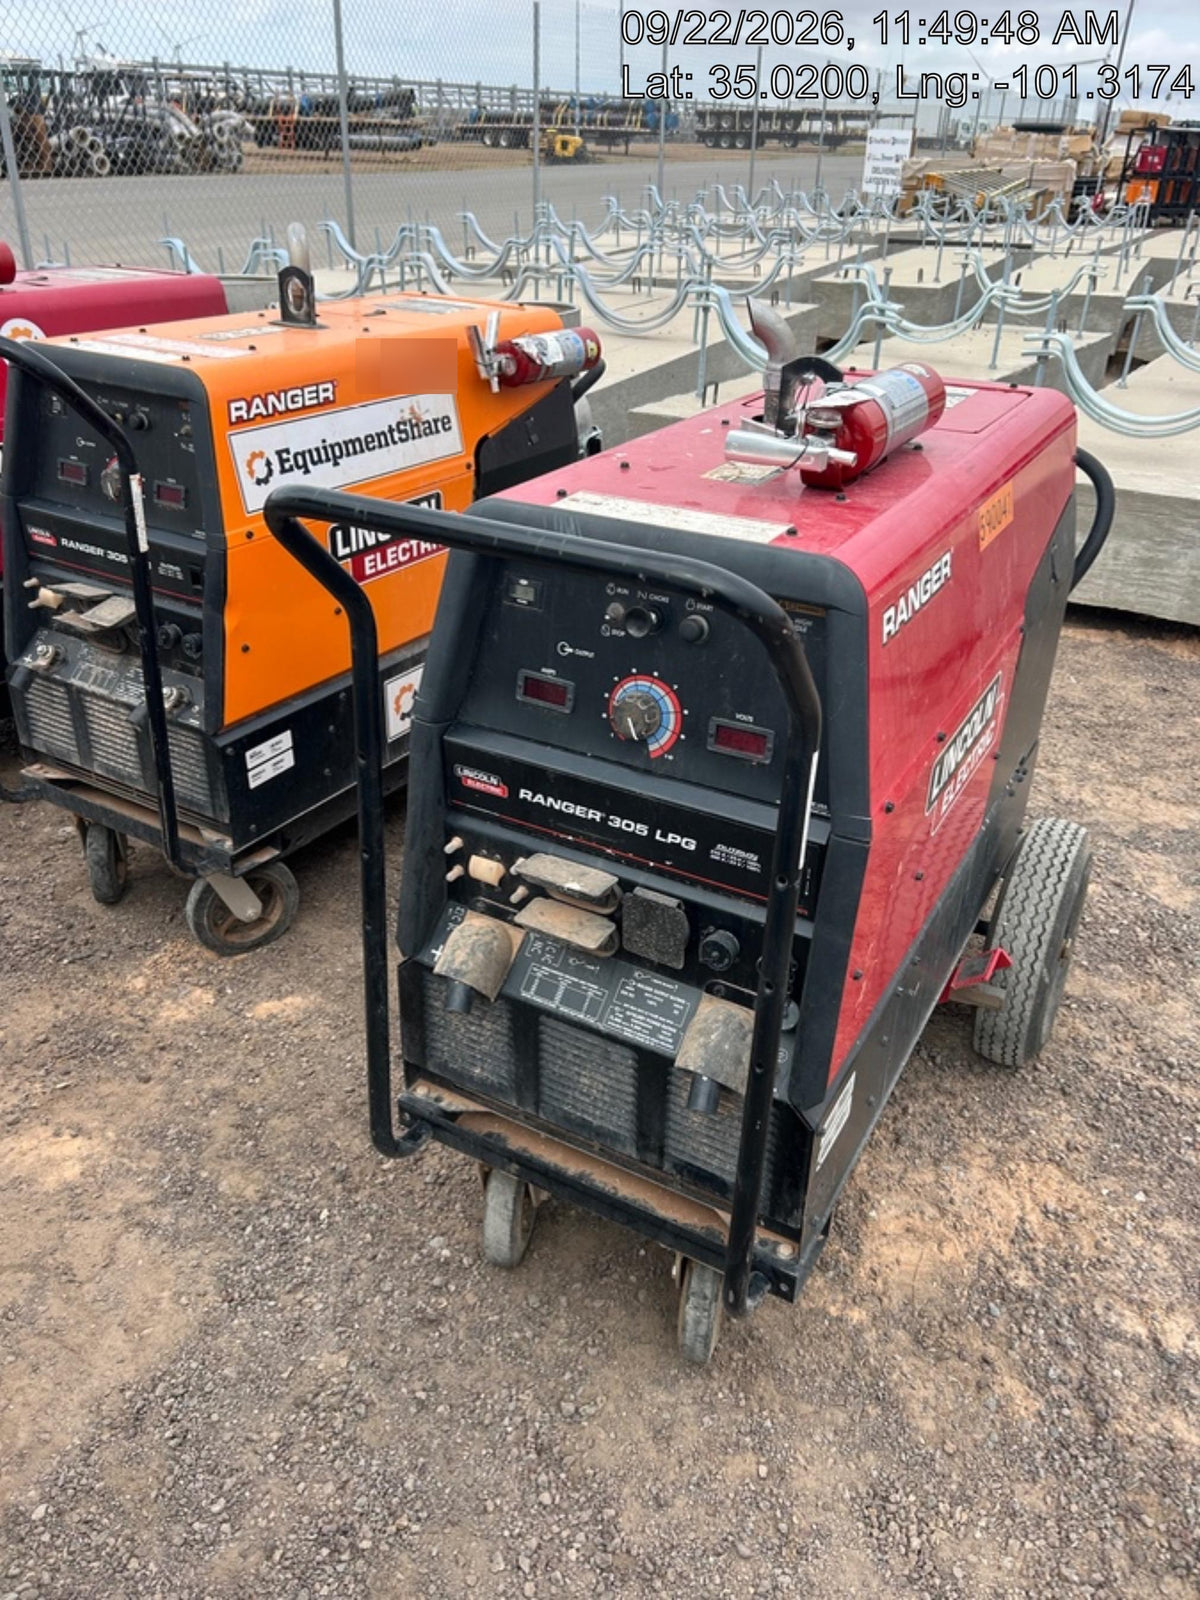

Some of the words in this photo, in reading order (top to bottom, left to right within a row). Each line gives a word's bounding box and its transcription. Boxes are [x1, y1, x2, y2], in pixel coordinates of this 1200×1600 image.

[229, 381, 335, 424] RANGER
[275, 414, 452, 477] EquipmentShare
[61, 537, 105, 557] RANGER
[363, 539, 442, 576] ELECTR
[881, 551, 952, 645] RANGER
[930, 683, 997, 801] LINCOLN
[519, 788, 602, 823] RANGER
[608, 815, 649, 837] 305
[655, 829, 697, 851] LPG
